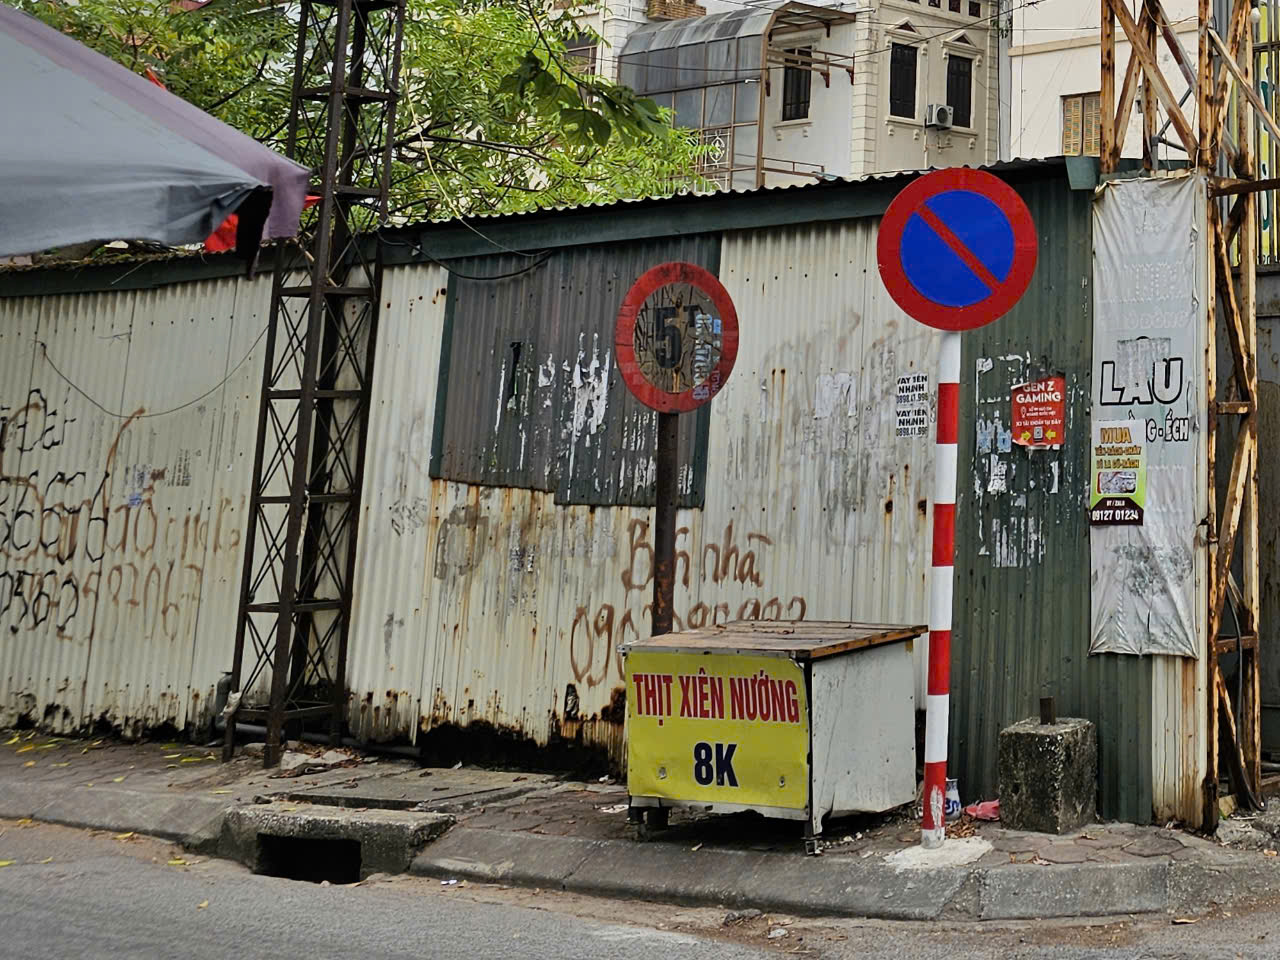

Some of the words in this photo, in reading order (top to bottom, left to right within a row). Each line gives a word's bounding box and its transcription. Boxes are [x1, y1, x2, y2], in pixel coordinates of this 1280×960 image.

[1023, 382, 1045, 392] GEN
[1047, 381, 1055, 391] Z
[1016, 392, 1061, 403] GAMING
[1101, 427, 1132, 444] MUA
[1092, 509, 1113, 521] 09127
[632, 674, 673, 726] THỊT
[678, 667, 724, 719] XIÊN
[729, 670, 799, 723] NƯỚNG
[693, 742, 738, 787] 8K
